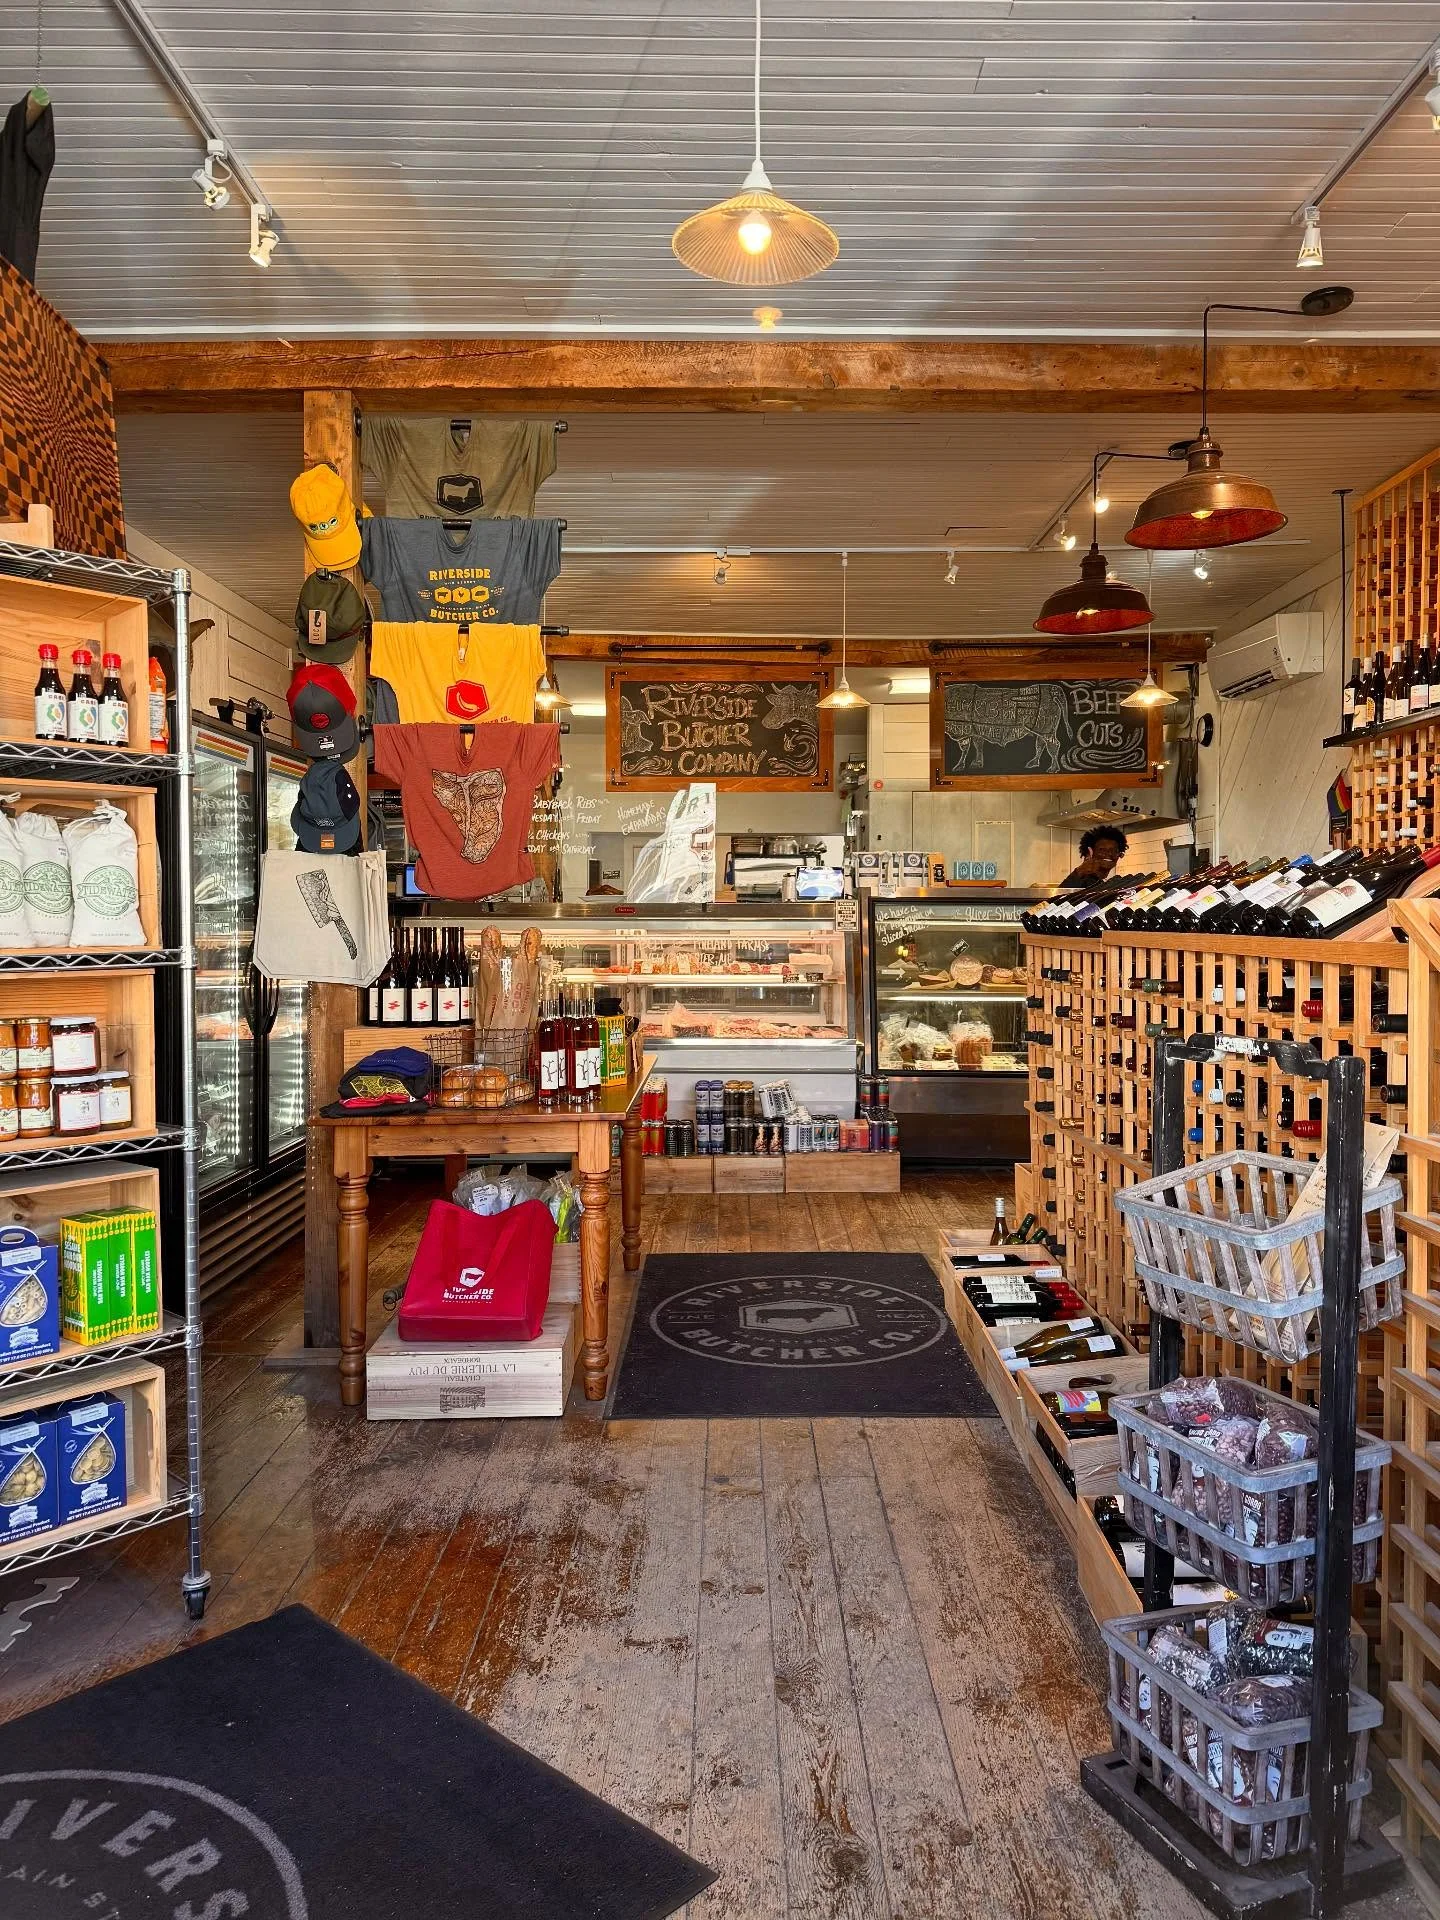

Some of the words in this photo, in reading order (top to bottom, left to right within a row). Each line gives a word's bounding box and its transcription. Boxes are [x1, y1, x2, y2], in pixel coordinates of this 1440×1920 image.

[429, 568, 491, 581] RIVERSIDE
[430, 608, 480, 621] BUTCHER
[482, 607, 499, 618] CO.
[641, 684, 758, 720] RIVERSIDE
[658, 719, 752, 752] BUTCHER
[1076, 720, 1124, 748] CUTS
[678, 749, 767, 775] COMPANY
[617, 799, 656, 820] HOMEMADE
[889, 907, 910, 919] have
[681, 1279, 906, 1307] RIVERSIDE
[680, 1328, 866, 1360] BUTCHER
[867, 1328, 922, 1349] CO.
[431, 1365, 448, 1375] DU
